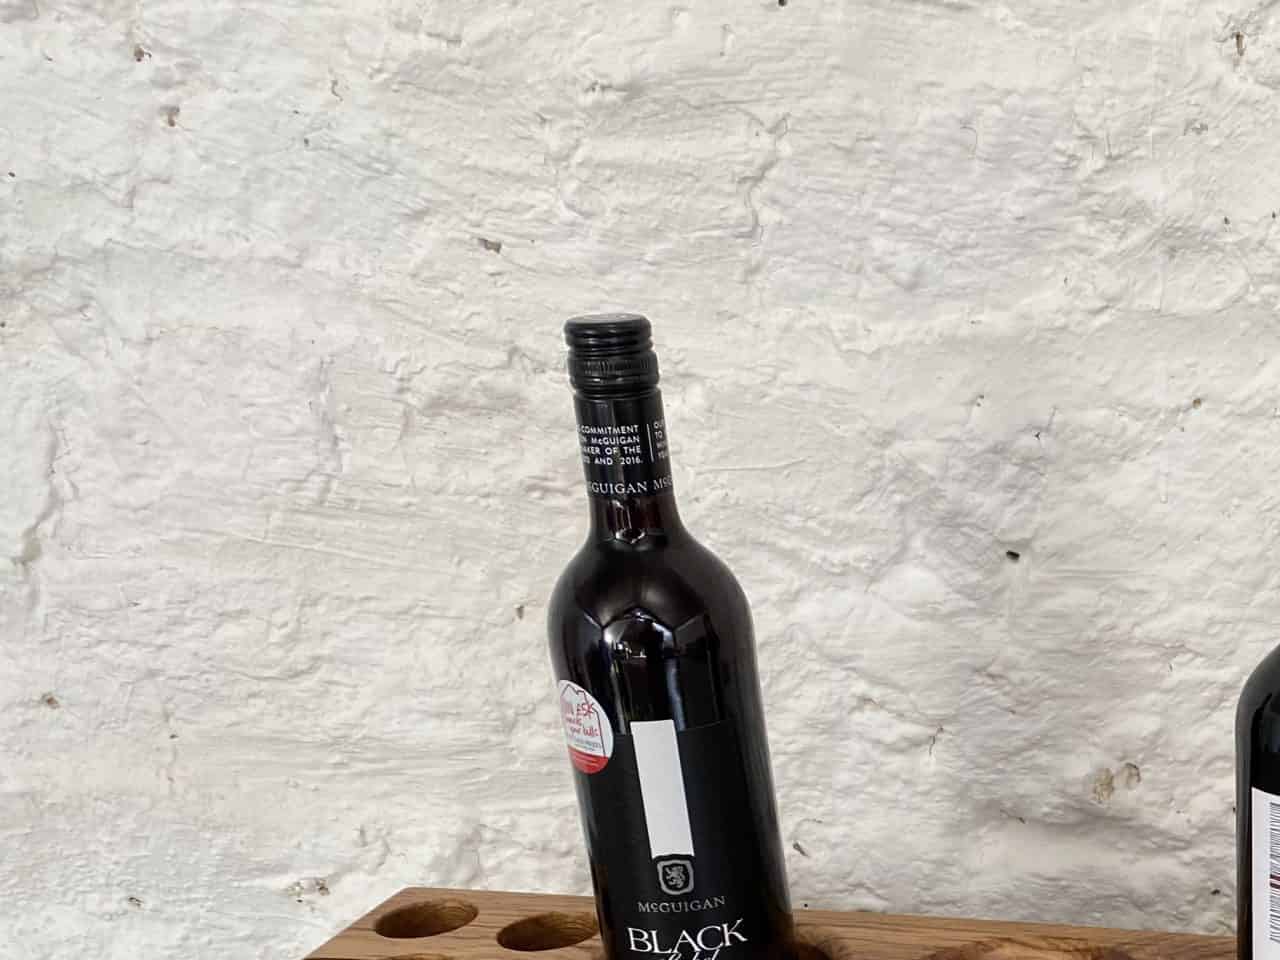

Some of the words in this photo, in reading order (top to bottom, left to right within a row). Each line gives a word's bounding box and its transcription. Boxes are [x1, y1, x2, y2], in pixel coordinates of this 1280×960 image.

[582, 424, 639, 435] COMMITMENT
[591, 435, 640, 445] McGUIGAN
[605, 447, 619, 455] OF
[623, 445, 641, 454] THE
[594, 457, 613, 466] AND
[637, 896, 725, 913] McGUIGAN
[627, 917, 748, 953] BLACK
